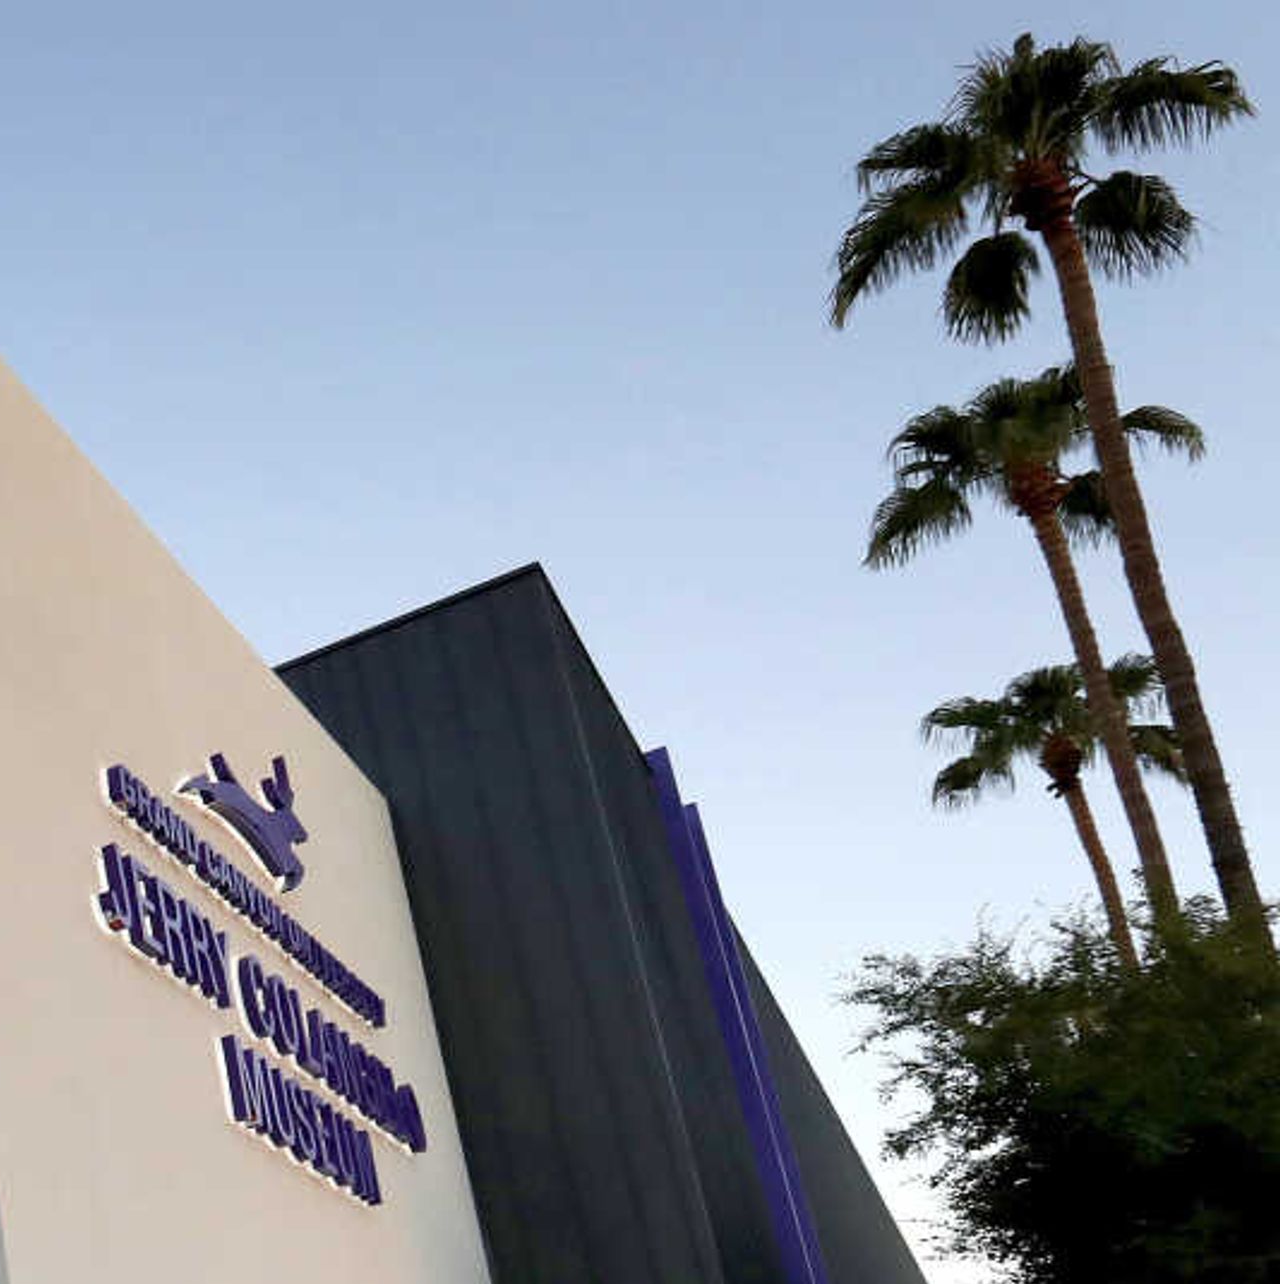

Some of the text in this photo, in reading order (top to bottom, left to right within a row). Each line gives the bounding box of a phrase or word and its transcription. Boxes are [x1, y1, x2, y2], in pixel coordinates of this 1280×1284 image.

[99, 843, 229, 1008] JERRY
[238, 953, 427, 1153] COLAN
[220, 1034, 382, 1206] MUSEUM
